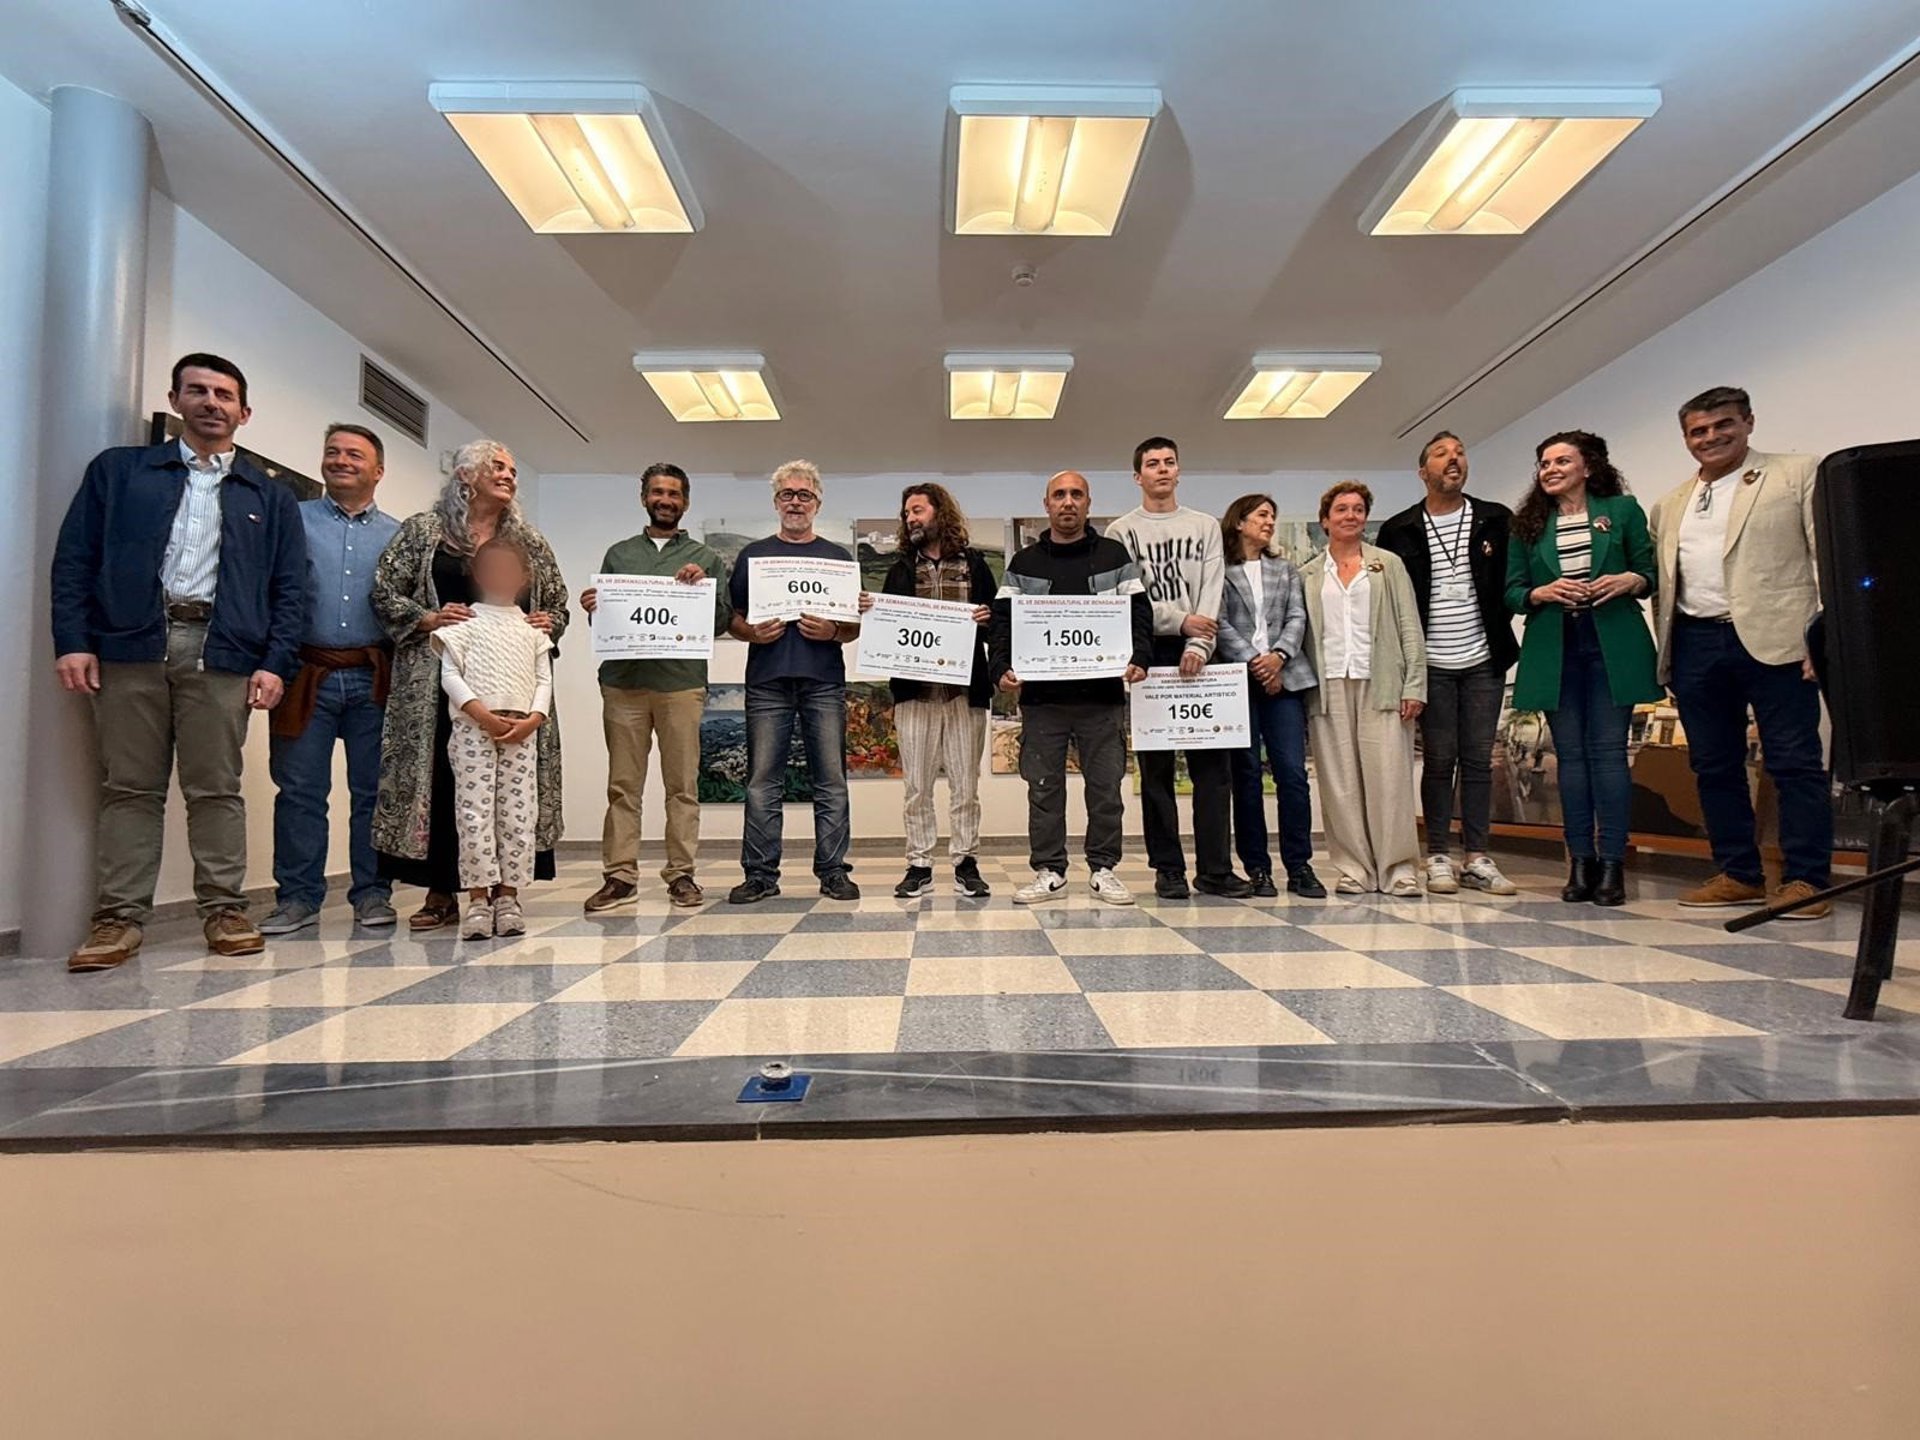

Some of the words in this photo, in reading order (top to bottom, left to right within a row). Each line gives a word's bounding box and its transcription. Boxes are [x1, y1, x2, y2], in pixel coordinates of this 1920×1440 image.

[788, 580, 830, 595] 600€
[630, 606, 679, 626] 400€
[897, 628, 942, 649] 300€
[1043, 629, 1102, 647] 1.500€
[1168, 703, 1214, 720] 150€
